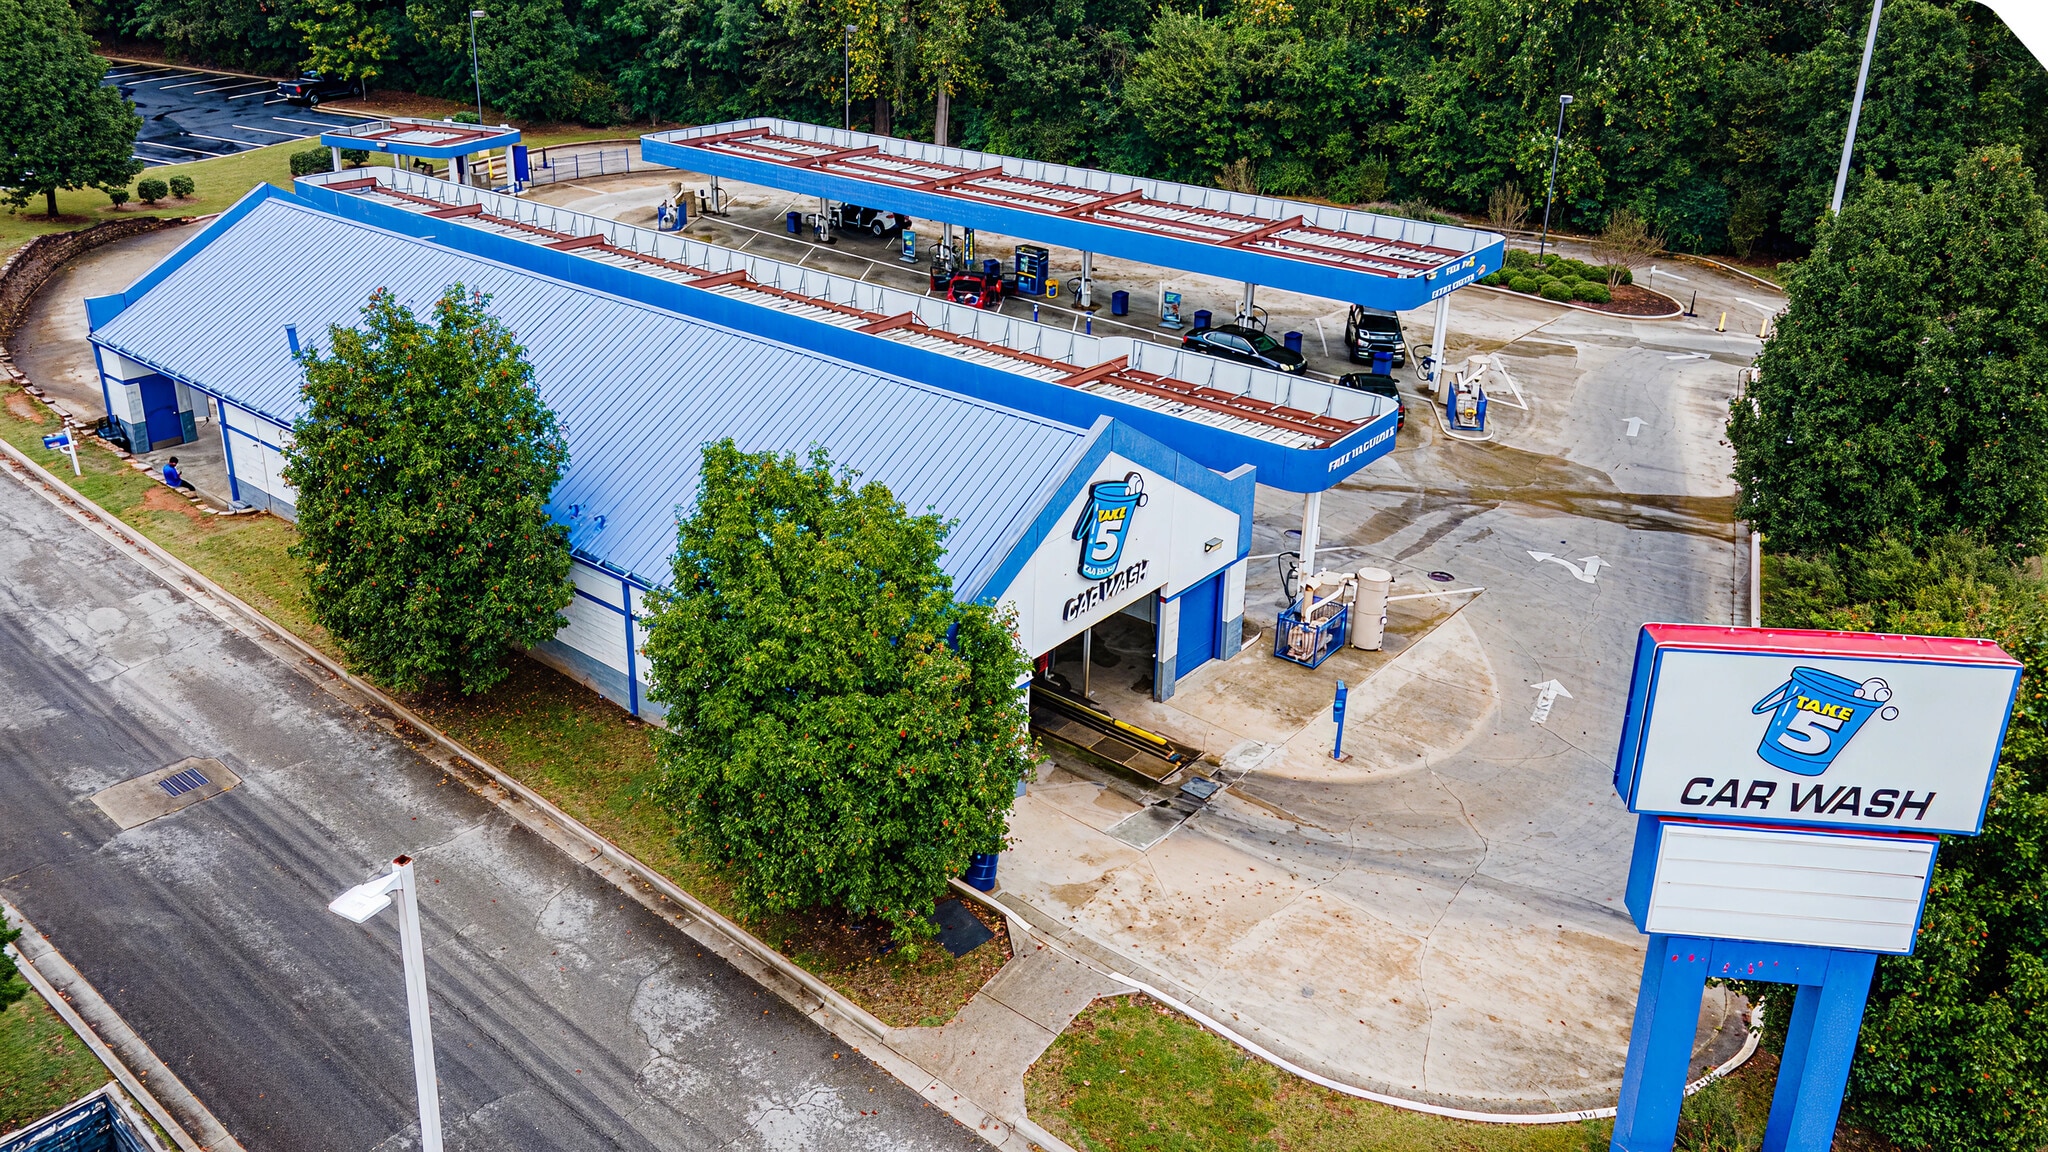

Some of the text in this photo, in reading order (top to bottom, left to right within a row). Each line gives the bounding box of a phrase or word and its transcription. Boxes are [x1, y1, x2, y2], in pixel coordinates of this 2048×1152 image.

[1098, 506, 1127, 523] TAKE
[1091, 519, 1124, 561] 5
[1062, 559, 1149, 622] CAR WASH
[1796, 695, 1854, 722] TAKE
[1777, 709, 1845, 756] 5
[1680, 777, 1937, 821] CAR WASH
